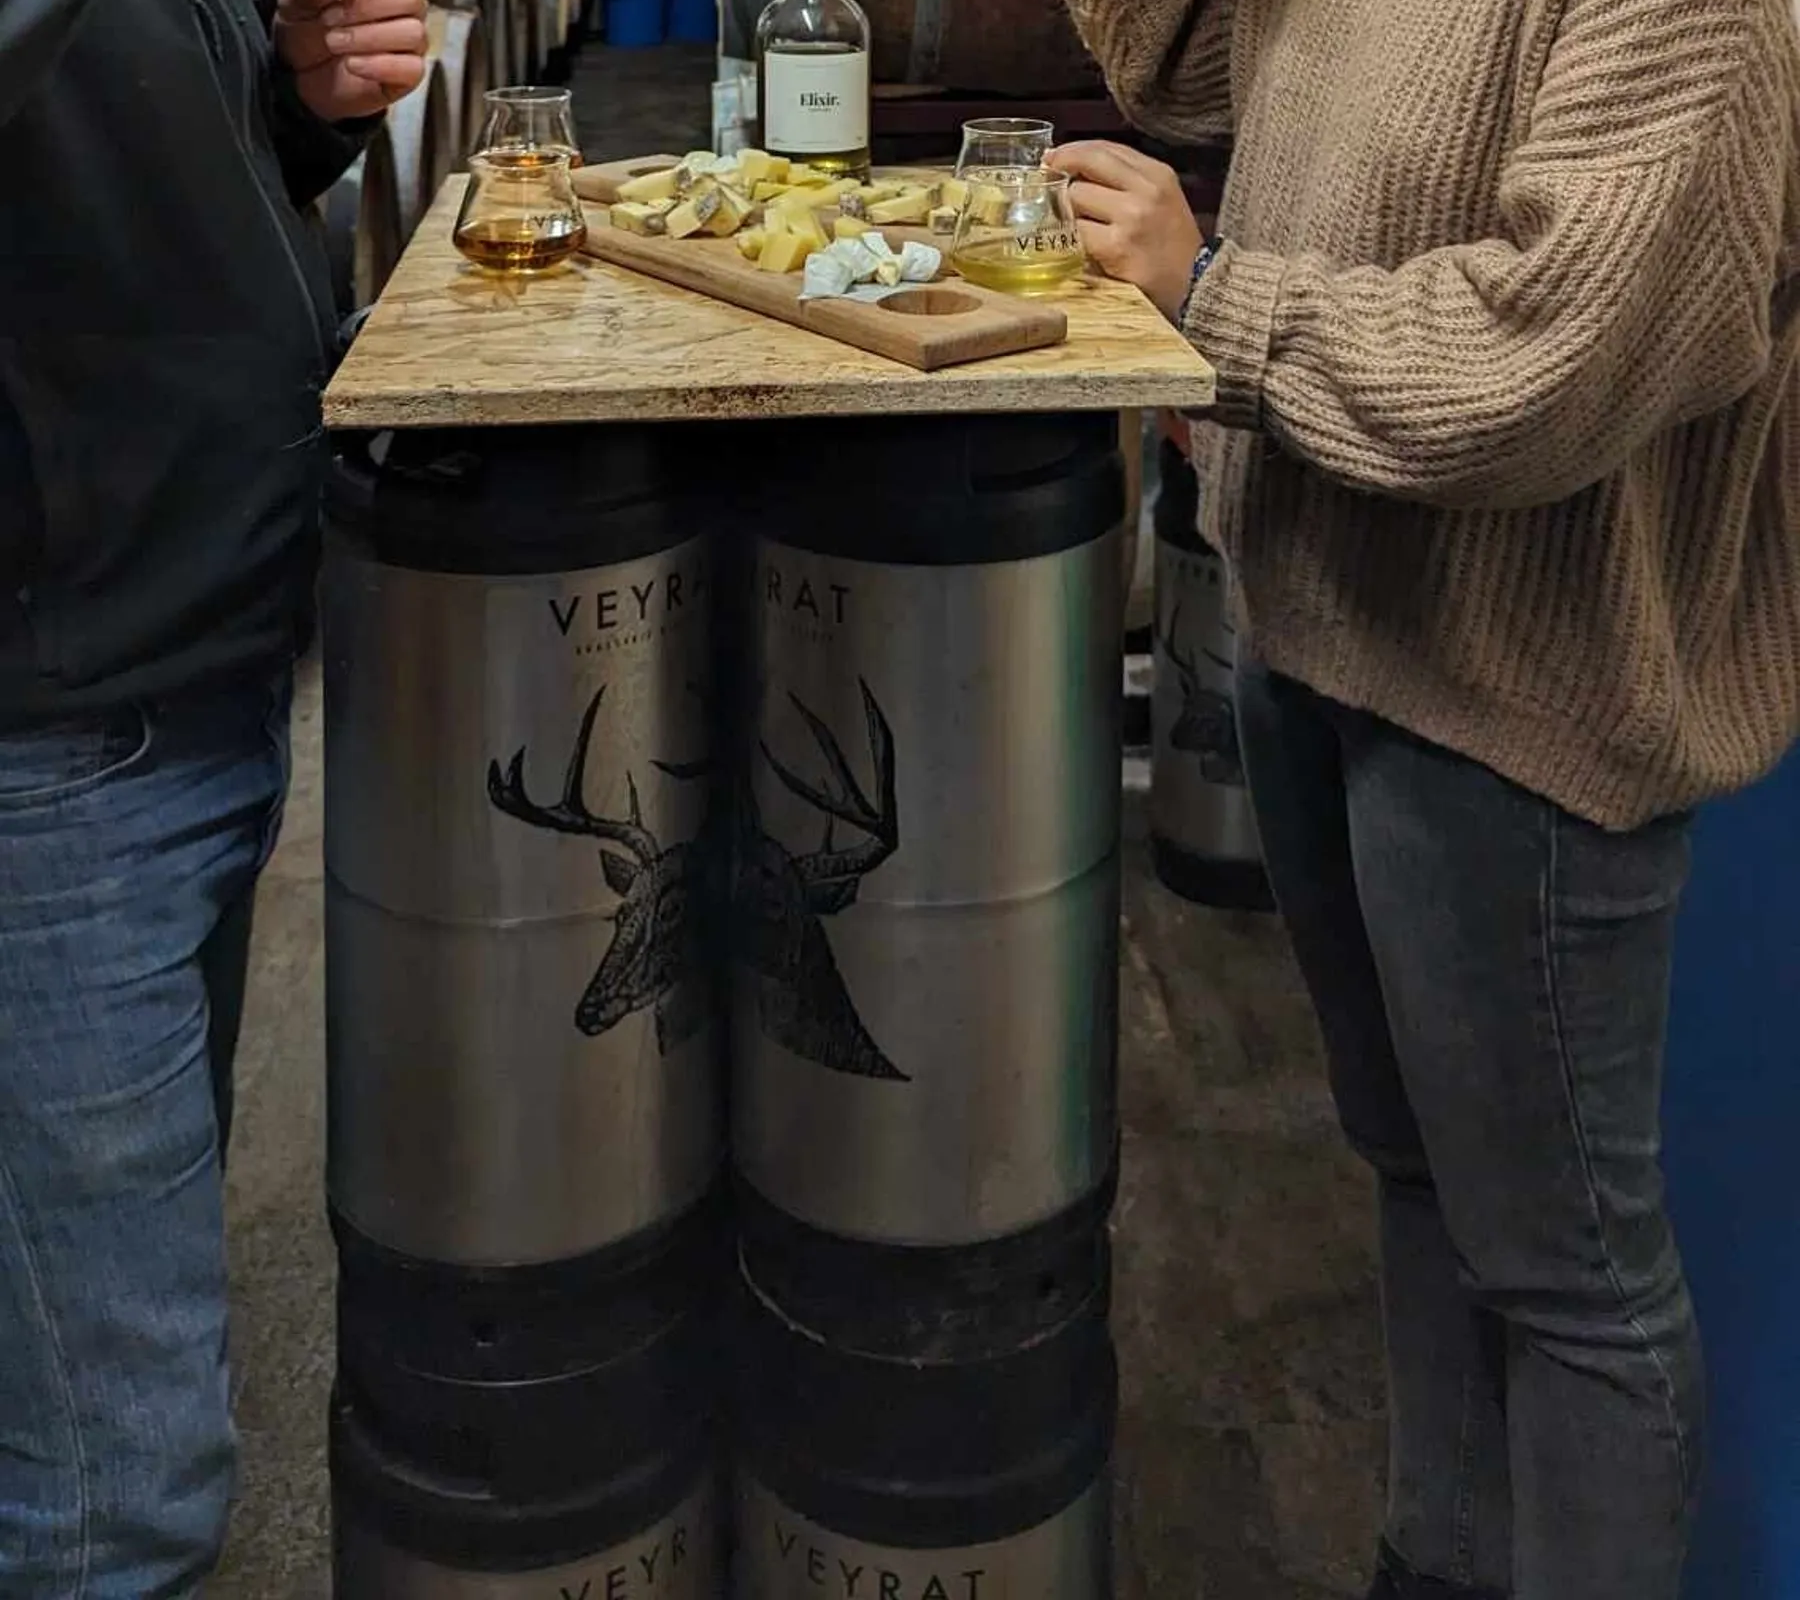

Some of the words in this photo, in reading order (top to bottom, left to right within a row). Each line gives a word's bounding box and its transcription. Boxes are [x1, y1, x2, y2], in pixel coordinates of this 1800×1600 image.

[800, 92, 841, 107] Elixir.
[763, 565, 850, 624] RAT
[774, 1521, 986, 1600] VEYRAT
